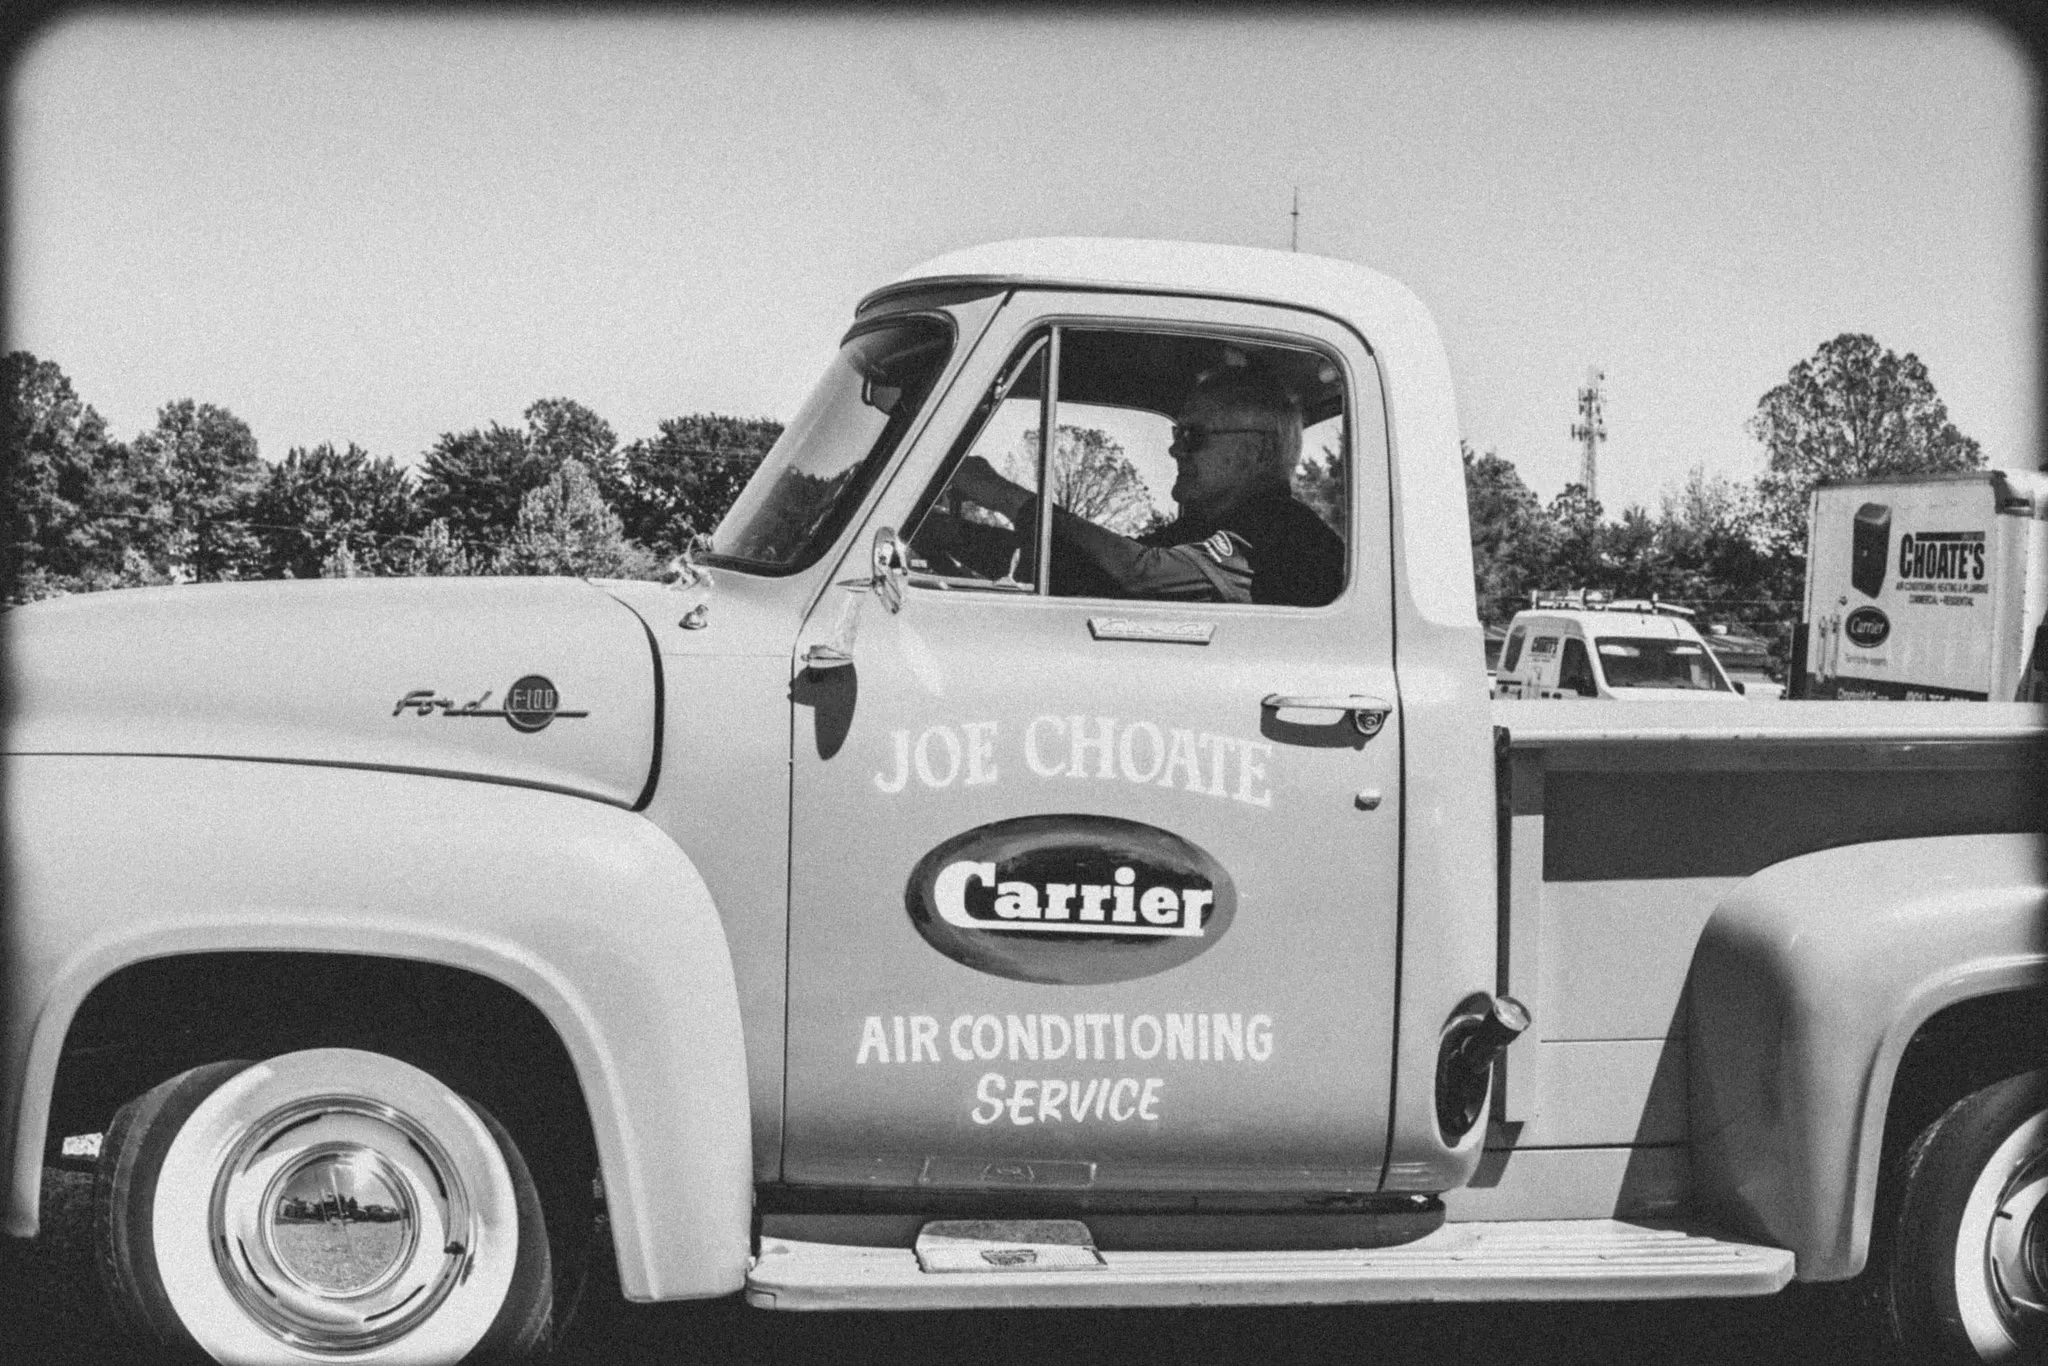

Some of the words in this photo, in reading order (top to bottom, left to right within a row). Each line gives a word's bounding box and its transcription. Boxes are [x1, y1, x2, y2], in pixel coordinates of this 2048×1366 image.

[1899, 533, 1985, 580] CHOATE'S
[392, 690, 493, 717] Ford
[512, 689, 555, 710] F-100
[873, 721, 998, 793] JOE
[1024, 714, 1273, 812] CHOATE
[933, 860, 1214, 937] Carrier
[856, 1014, 941, 1064] AIR
[949, 1012, 1273, 1062] CONDITIONING
[971, 1072, 1164, 1125] SERVICE
